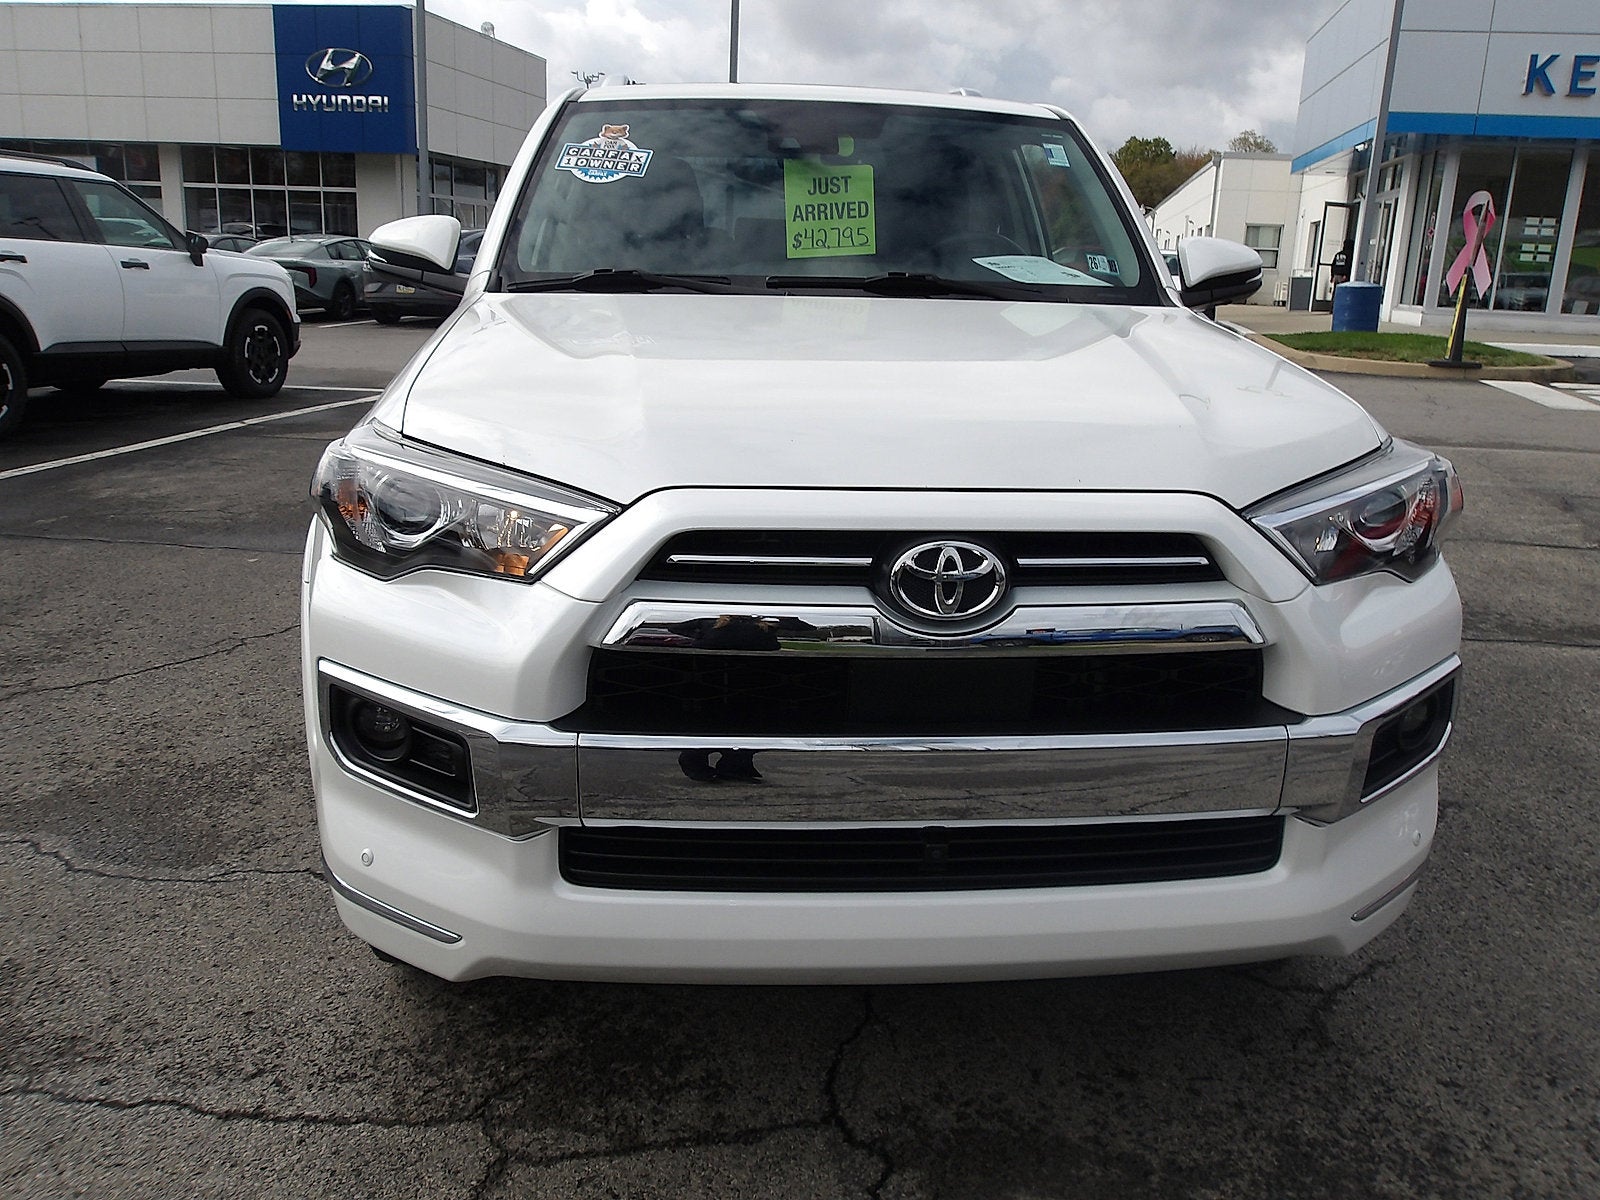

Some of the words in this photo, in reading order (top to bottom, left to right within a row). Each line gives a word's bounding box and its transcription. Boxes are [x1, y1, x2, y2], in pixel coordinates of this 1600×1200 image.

[292, 94, 389, 113] HYUNDAI
[568, 148, 644, 163] CARFAX
[577, 159, 640, 172] OWNER
[808, 175, 851, 195] JUST
[792, 201, 869, 222] ARRIVED
[1088, 256, 1099, 270] 26
